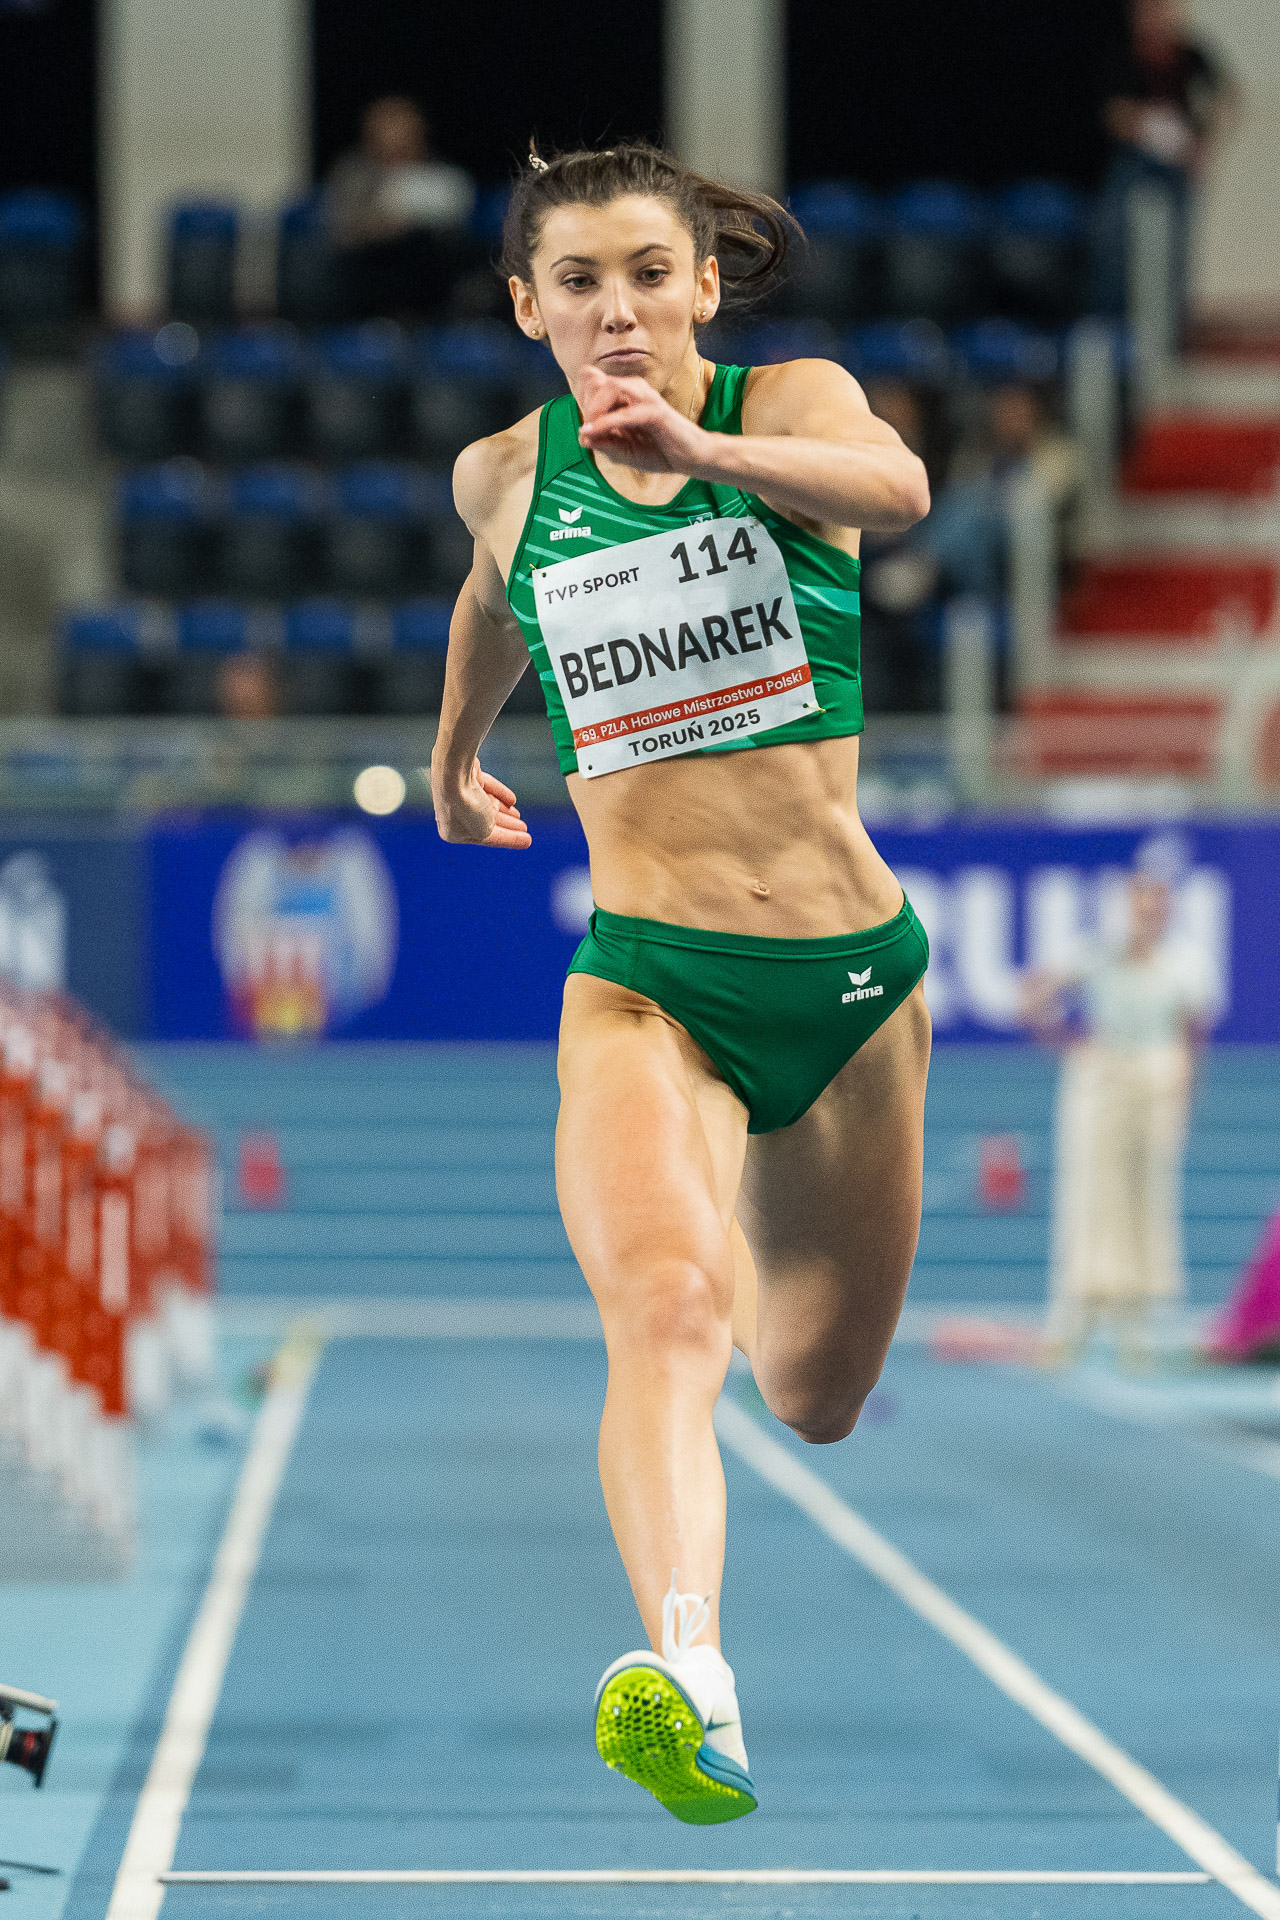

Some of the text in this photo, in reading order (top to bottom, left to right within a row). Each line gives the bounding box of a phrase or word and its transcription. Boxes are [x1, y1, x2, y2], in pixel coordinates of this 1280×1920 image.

[549, 526, 591, 541] erima
[670, 526, 758, 583] 114
[545, 567, 640, 604] TVP SPORT
[559, 596, 793, 699] BEDNAREK
[600, 720, 629, 736] PZLA
[631, 707, 681, 728] Halowe
[683, 684, 764, 715] Mistrzostwa
[765, 669, 803, 692] Polski
[628, 708, 761, 756] TORUŃ 2025
[841, 985, 884, 1003] erima
